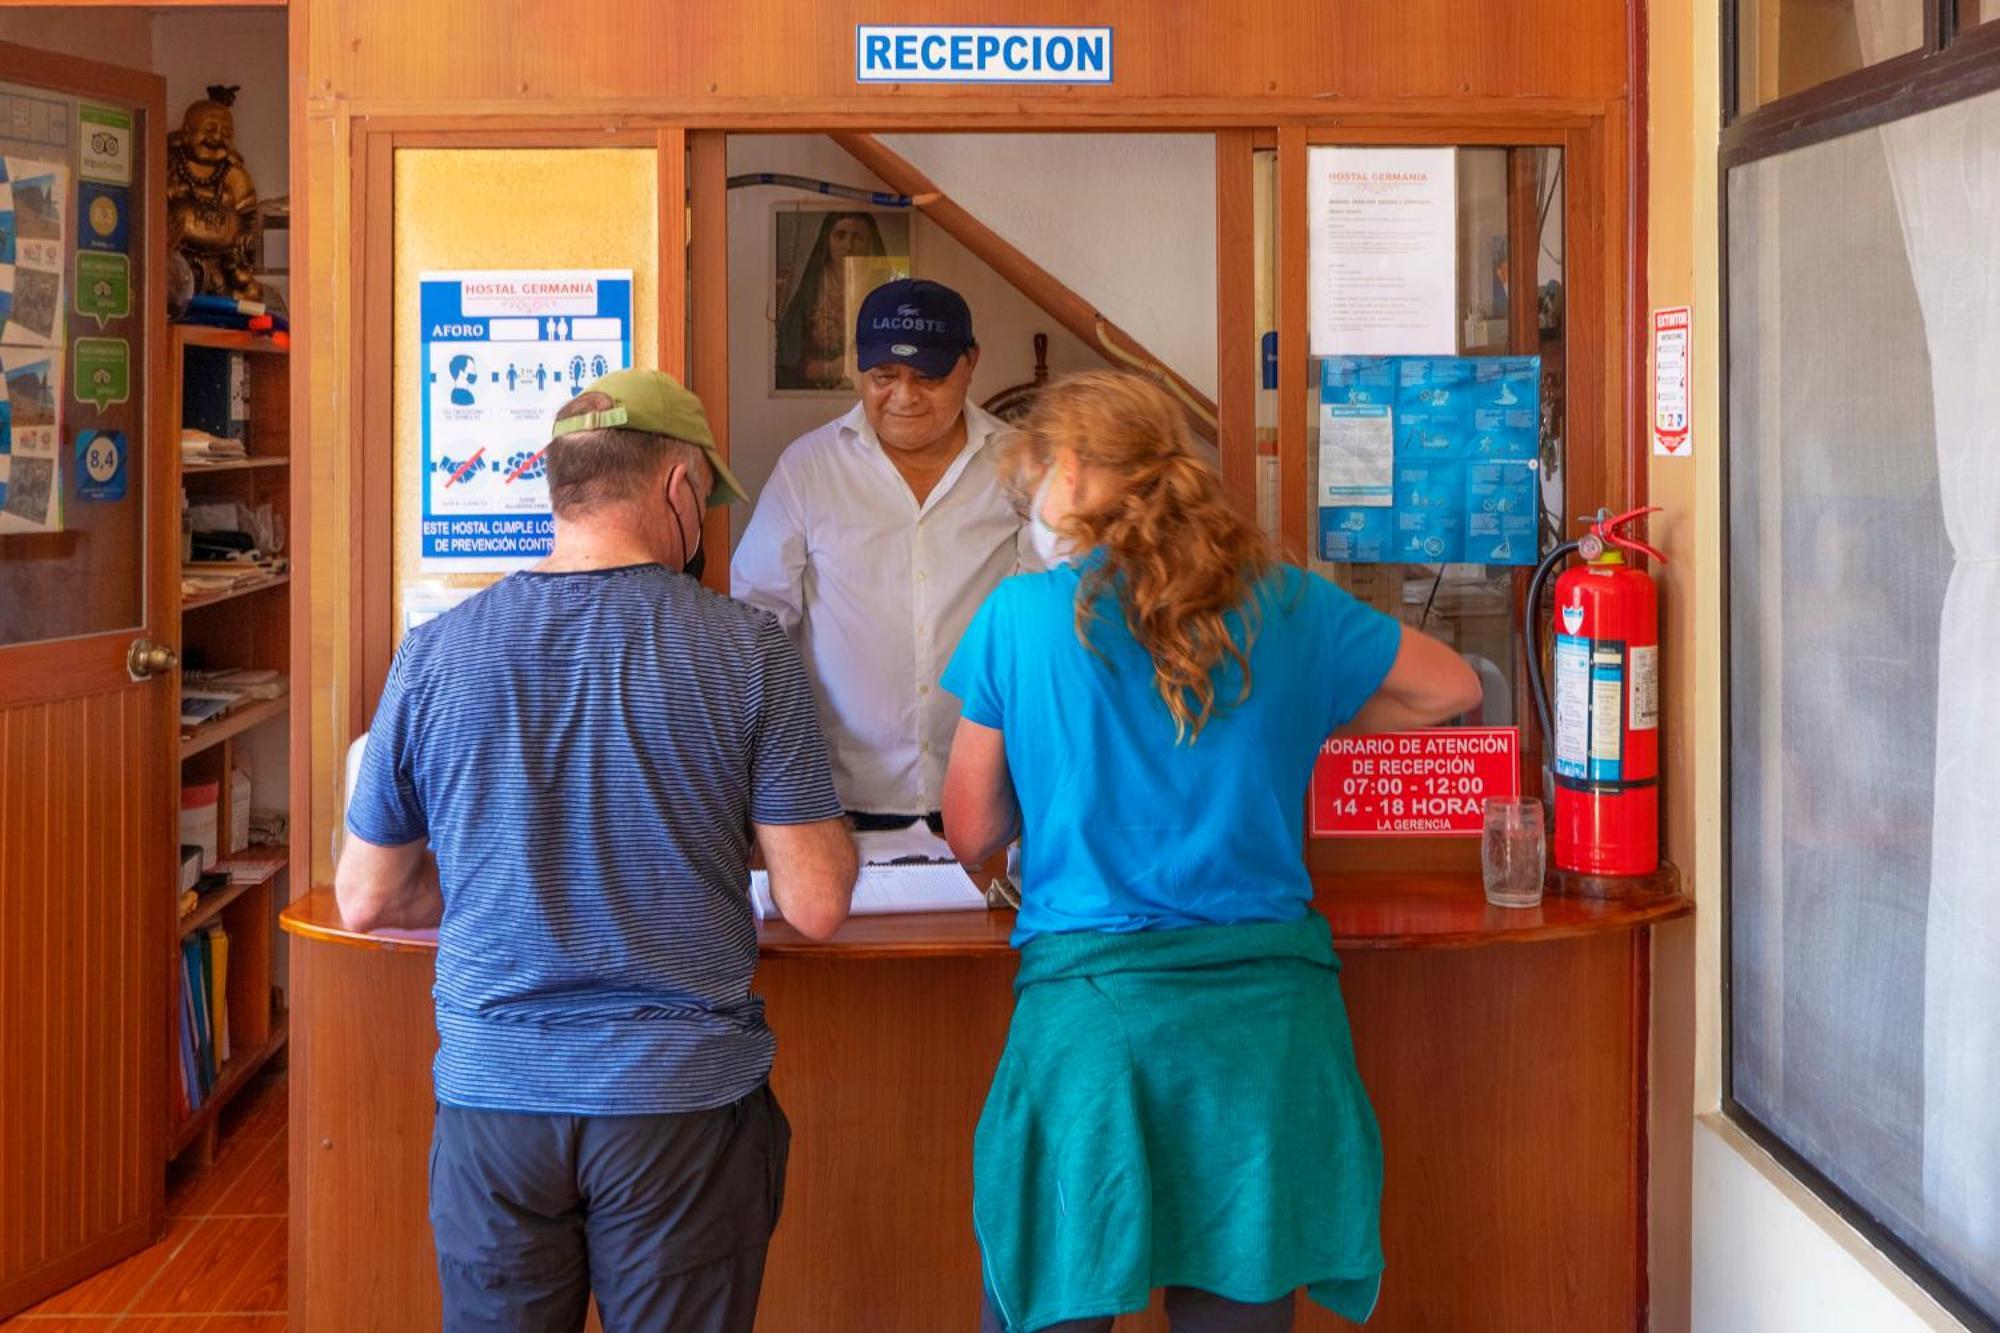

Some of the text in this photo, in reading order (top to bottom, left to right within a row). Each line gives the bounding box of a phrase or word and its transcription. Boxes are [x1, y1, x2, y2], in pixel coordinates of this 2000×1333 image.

[866, 35, 1104, 72] RECEPCION
[1328, 172, 1368, 182] HOSTAL
[465, 282, 594, 295] HOSTAL GERMANIA
[432, 324, 484, 337] AFORO
[873, 317, 946, 333] LACOSTE
[91, 449, 114, 470] 8,4
[423, 520, 556, 535] ESTE HOSTAL CUMPLE LOS
[435, 538, 449, 552] DE
[451, 535, 516, 551] PREVENCIÓN
[1319, 734, 1508, 755] HORARIO DE ATENCIÓN
[1352, 756, 1475, 775] DE RECEPCIÓN
[1343, 778, 1403, 795] 07:00
[1425, 777, 1483, 794] 12:00
[1333, 799, 1358, 816] 14
[1380, 798, 1404, 815] 18
[1377, 819, 1451, 831] LA GERENCIA
